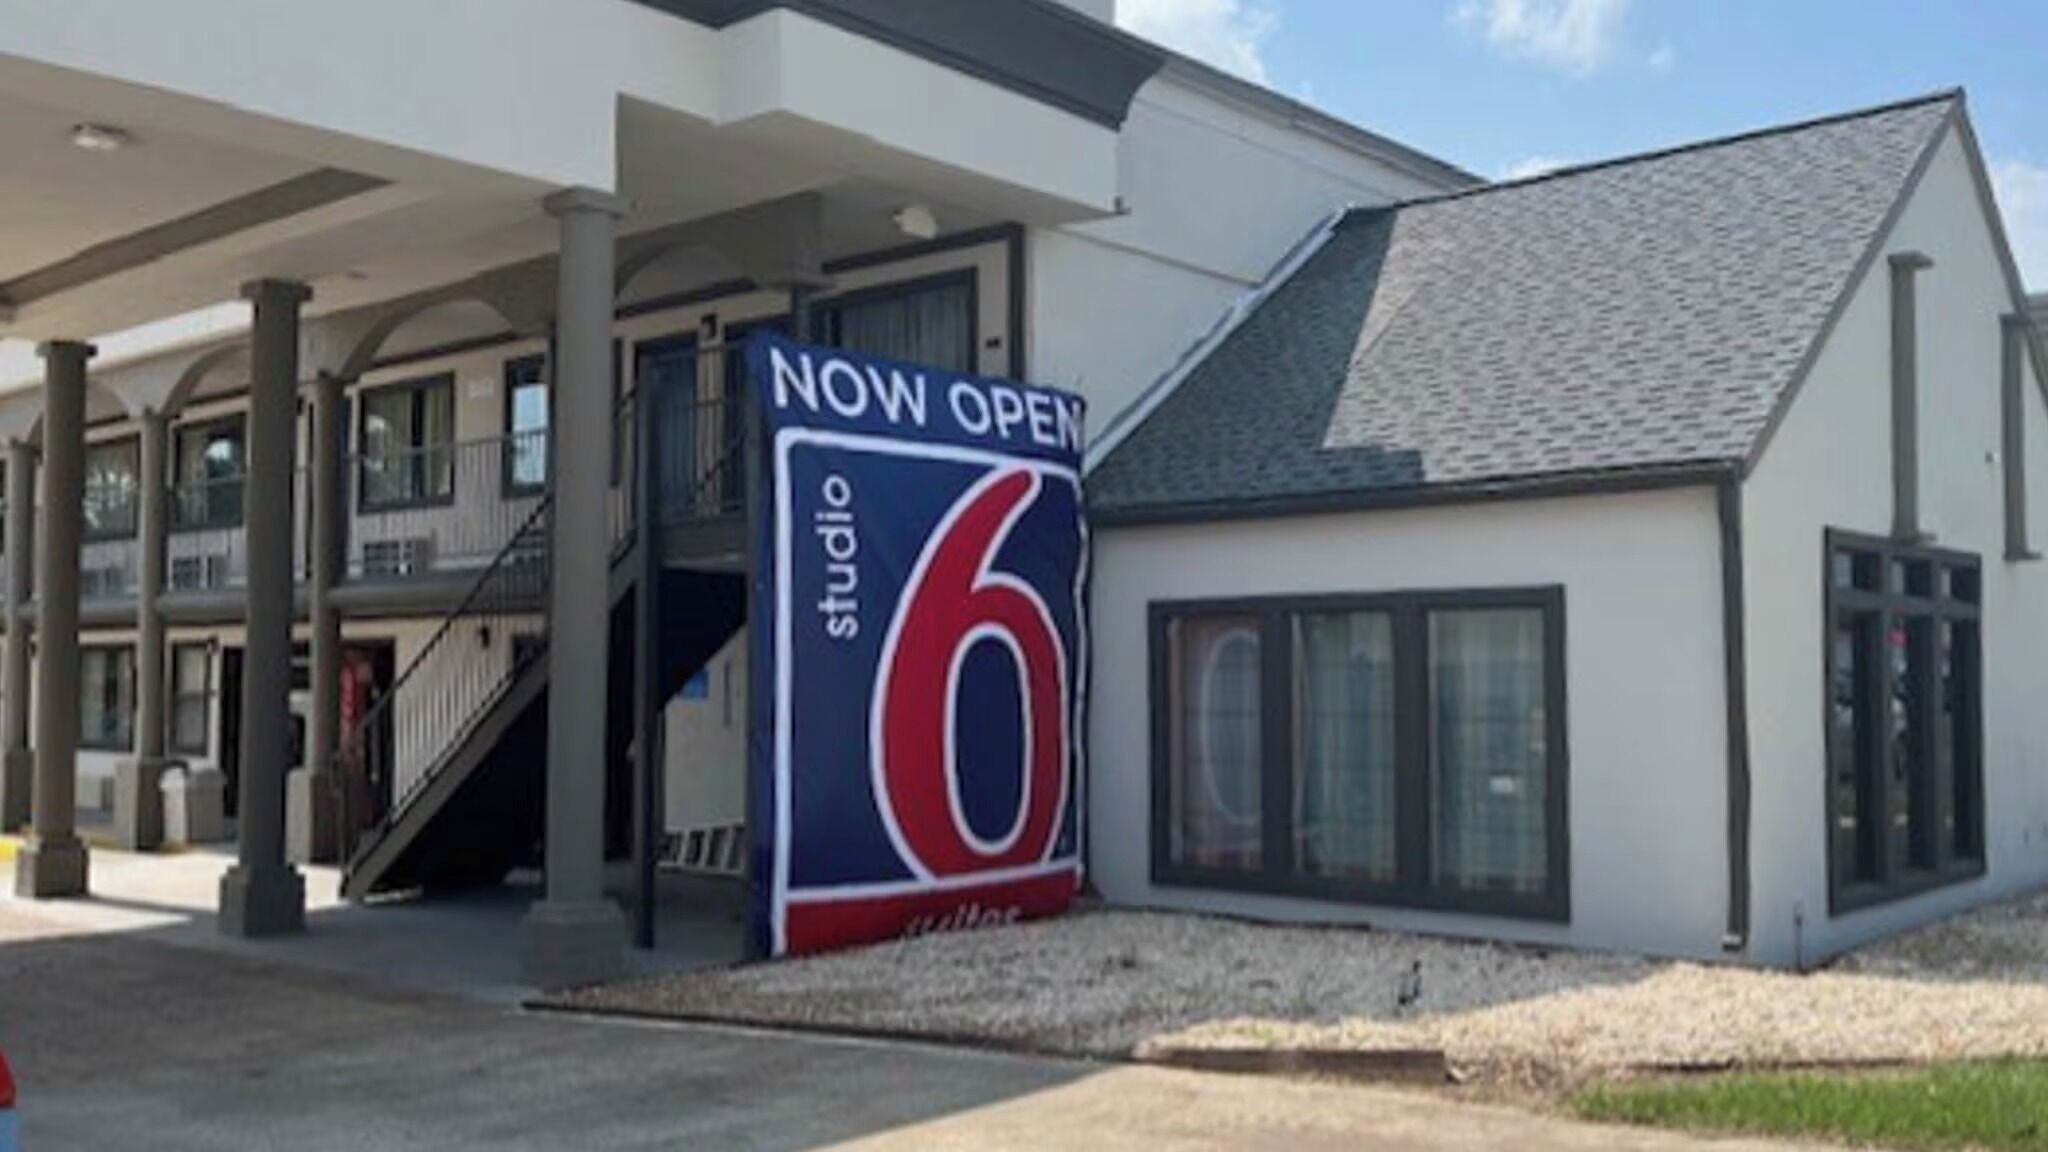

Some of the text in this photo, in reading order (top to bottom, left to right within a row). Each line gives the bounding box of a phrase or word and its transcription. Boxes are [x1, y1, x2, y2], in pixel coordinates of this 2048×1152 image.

[770, 347, 1085, 447] NOW OPEN
[814, 474, 859, 639] studio
[870, 464, 1069, 880] 6
